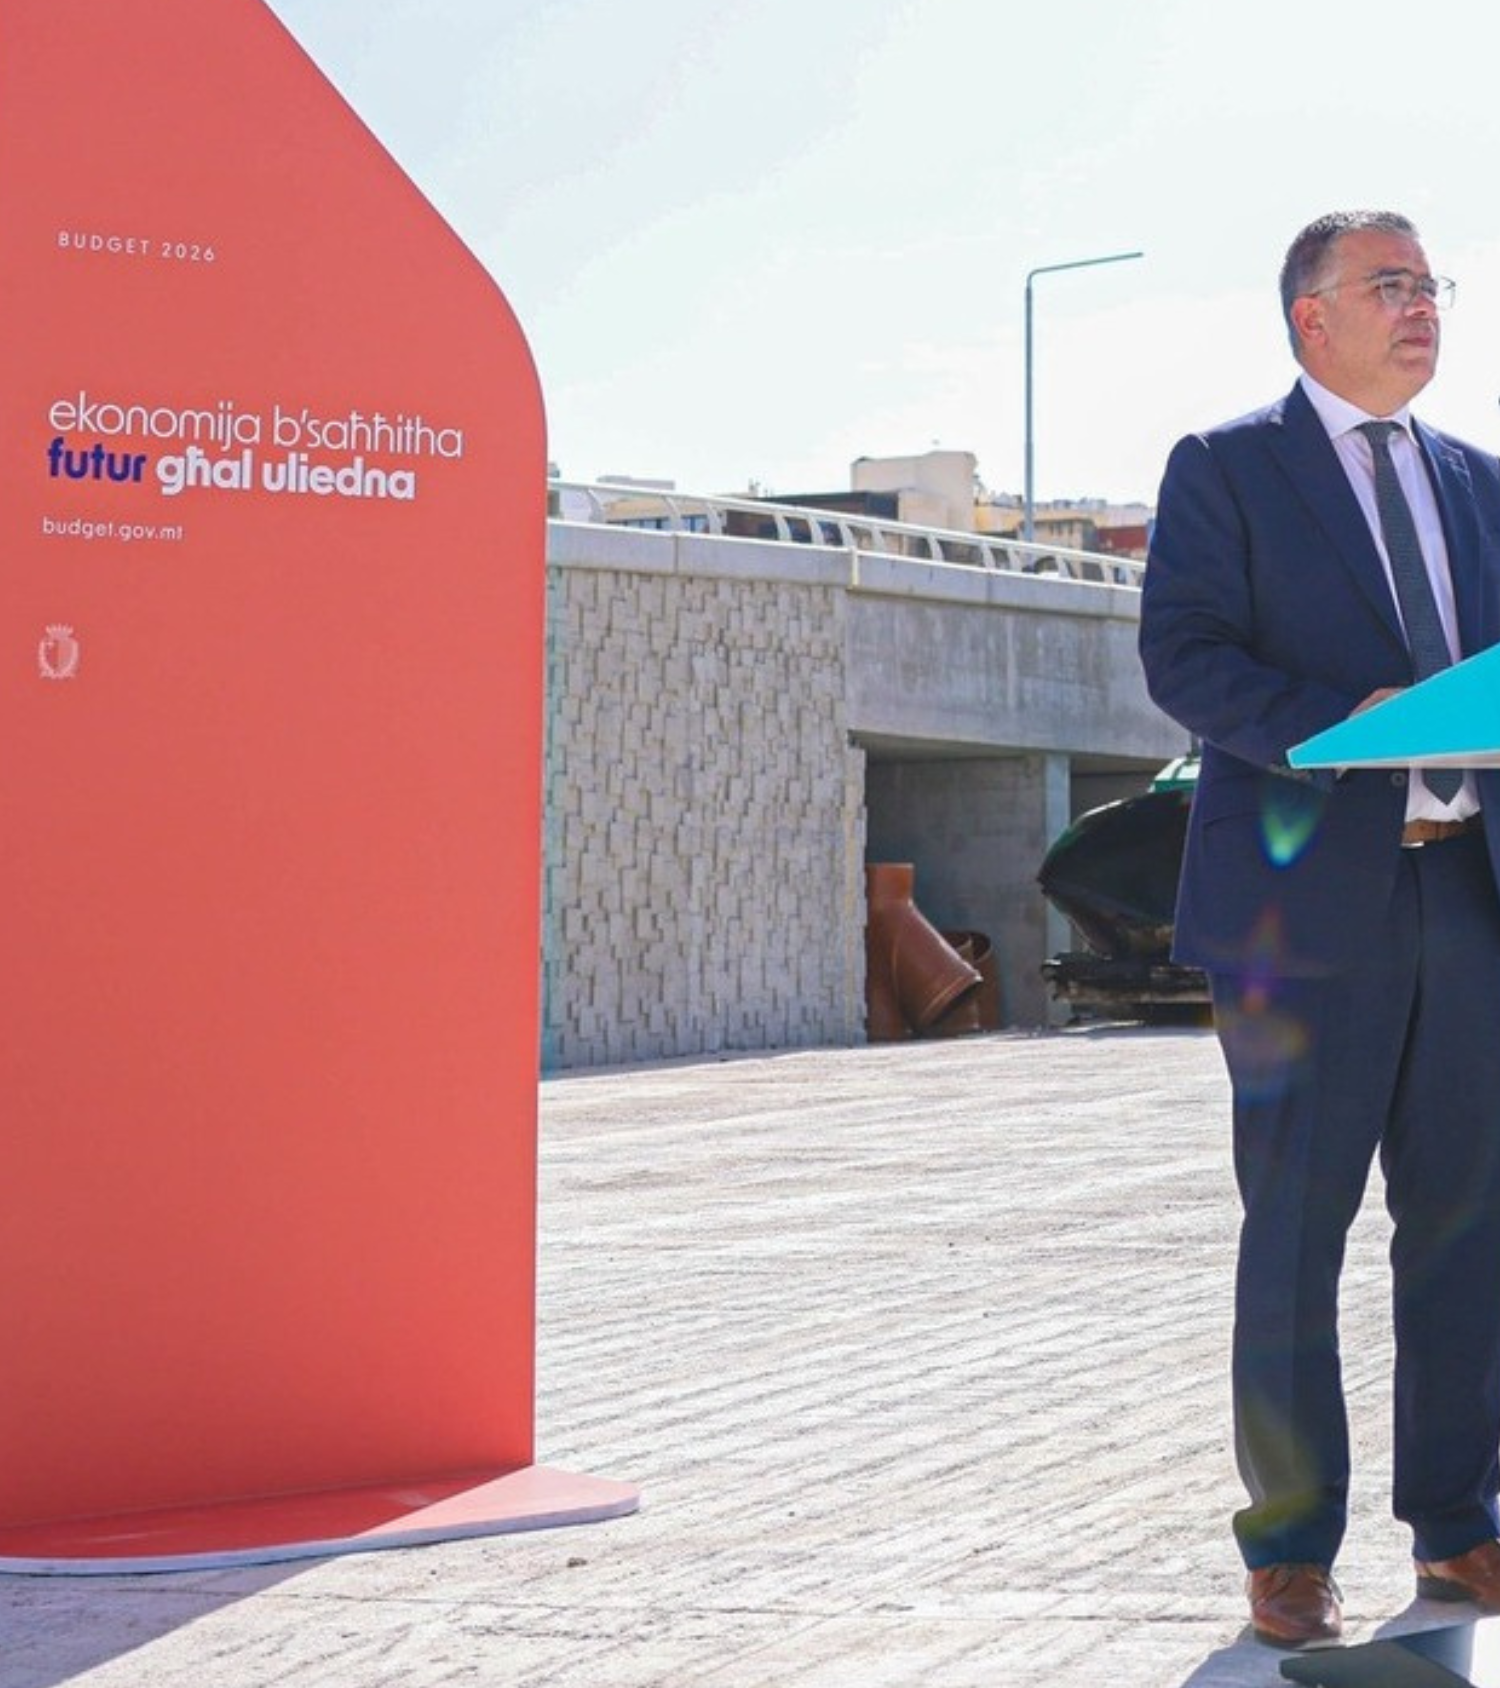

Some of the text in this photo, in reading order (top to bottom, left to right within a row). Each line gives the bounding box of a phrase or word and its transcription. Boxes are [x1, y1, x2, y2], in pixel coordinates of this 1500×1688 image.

[58, 231, 215, 262] BUDGET 2026
[49, 390, 463, 458] ekonomija b'saħħitha
[48, 436, 416, 500] futur għal uliedna
[43, 516, 183, 541] budget.gov.mt
